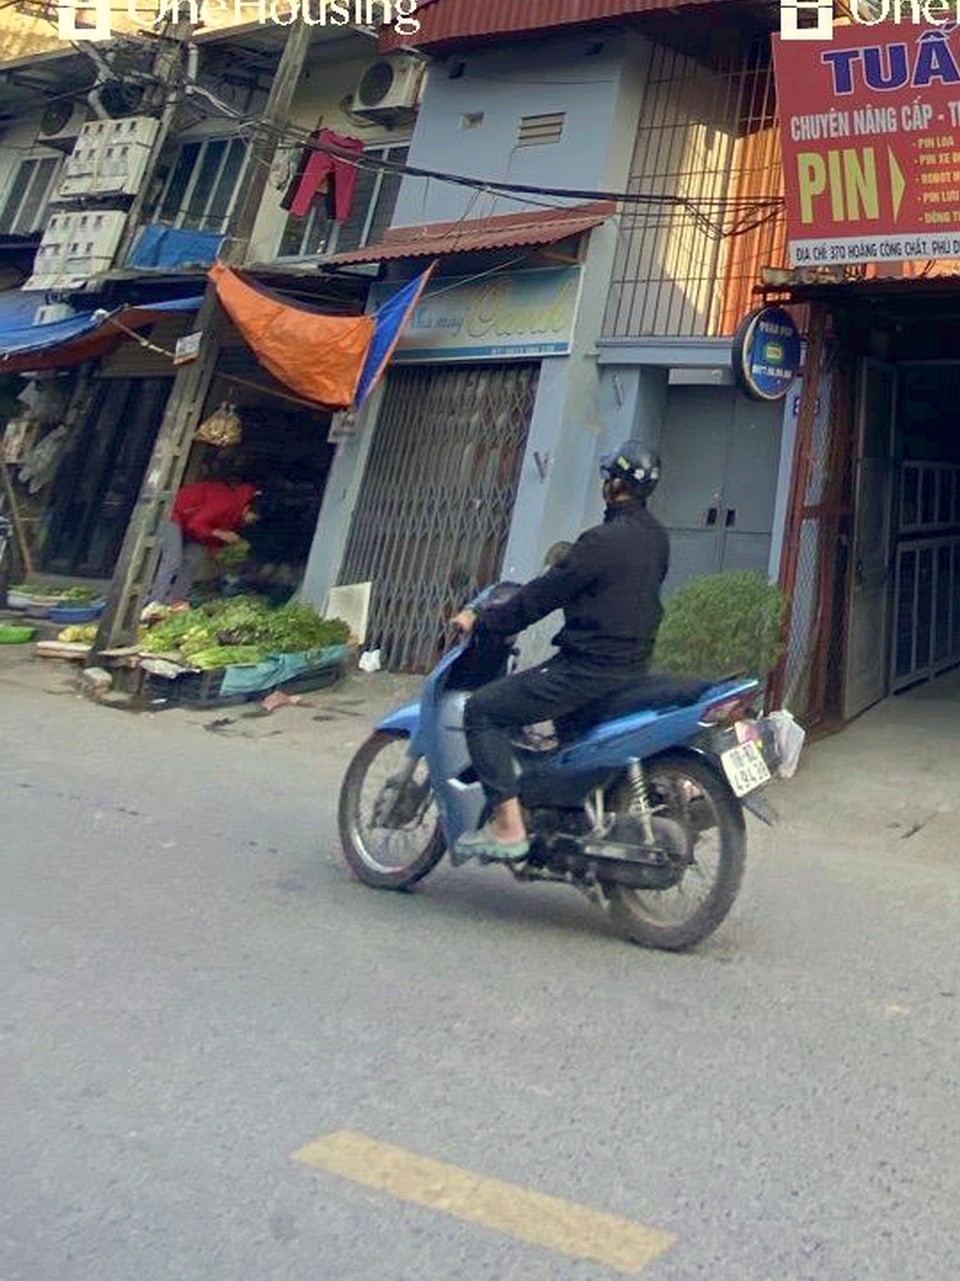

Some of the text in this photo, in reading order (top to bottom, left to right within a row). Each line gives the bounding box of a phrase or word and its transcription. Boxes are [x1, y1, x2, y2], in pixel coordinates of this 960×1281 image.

[791, 107, 849, 141] CHUYÊN
[853, 103, 898, 135] NÂNG
[901, 96, 933, 132] CẤP
[797, 146, 881, 224] PIN
